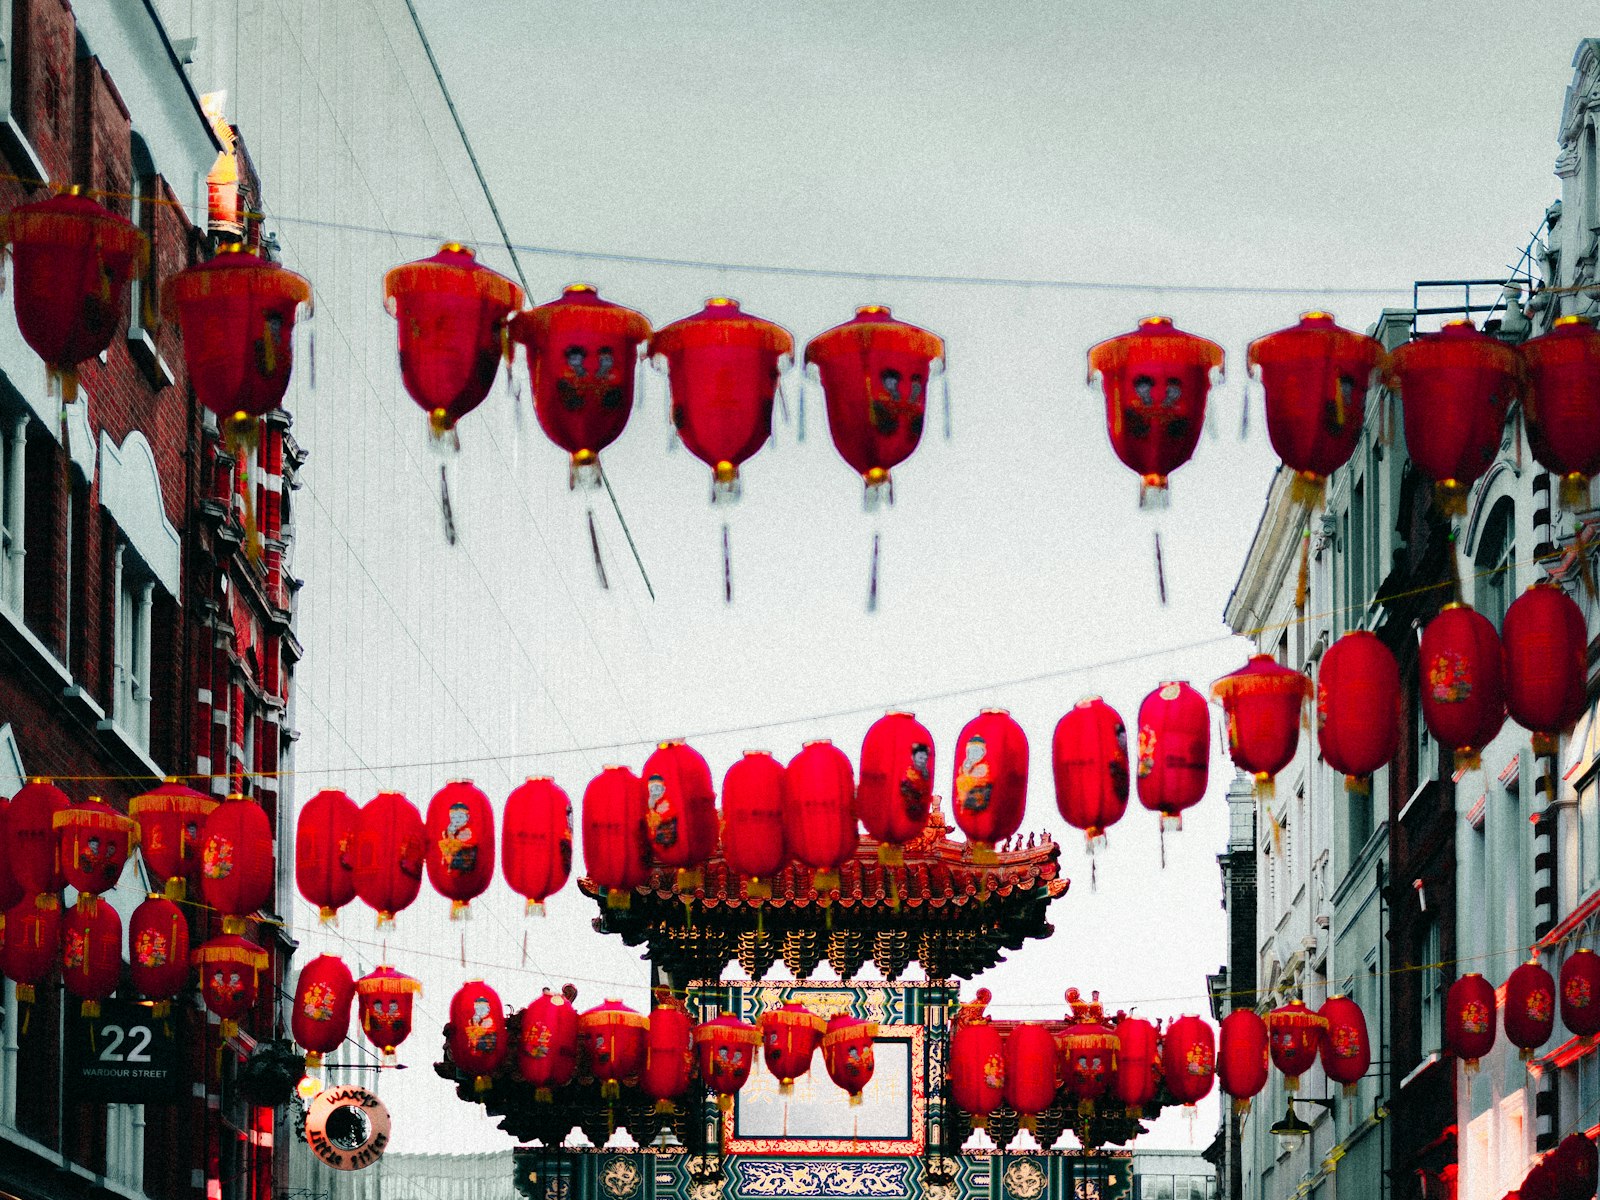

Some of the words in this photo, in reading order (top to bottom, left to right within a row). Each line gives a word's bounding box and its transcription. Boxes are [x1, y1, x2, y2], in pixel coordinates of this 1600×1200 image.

[99, 1024, 152, 1062] 22
[83, 1068, 129, 1077] WARDOUR
[132, 1069, 167, 1078] STREET
